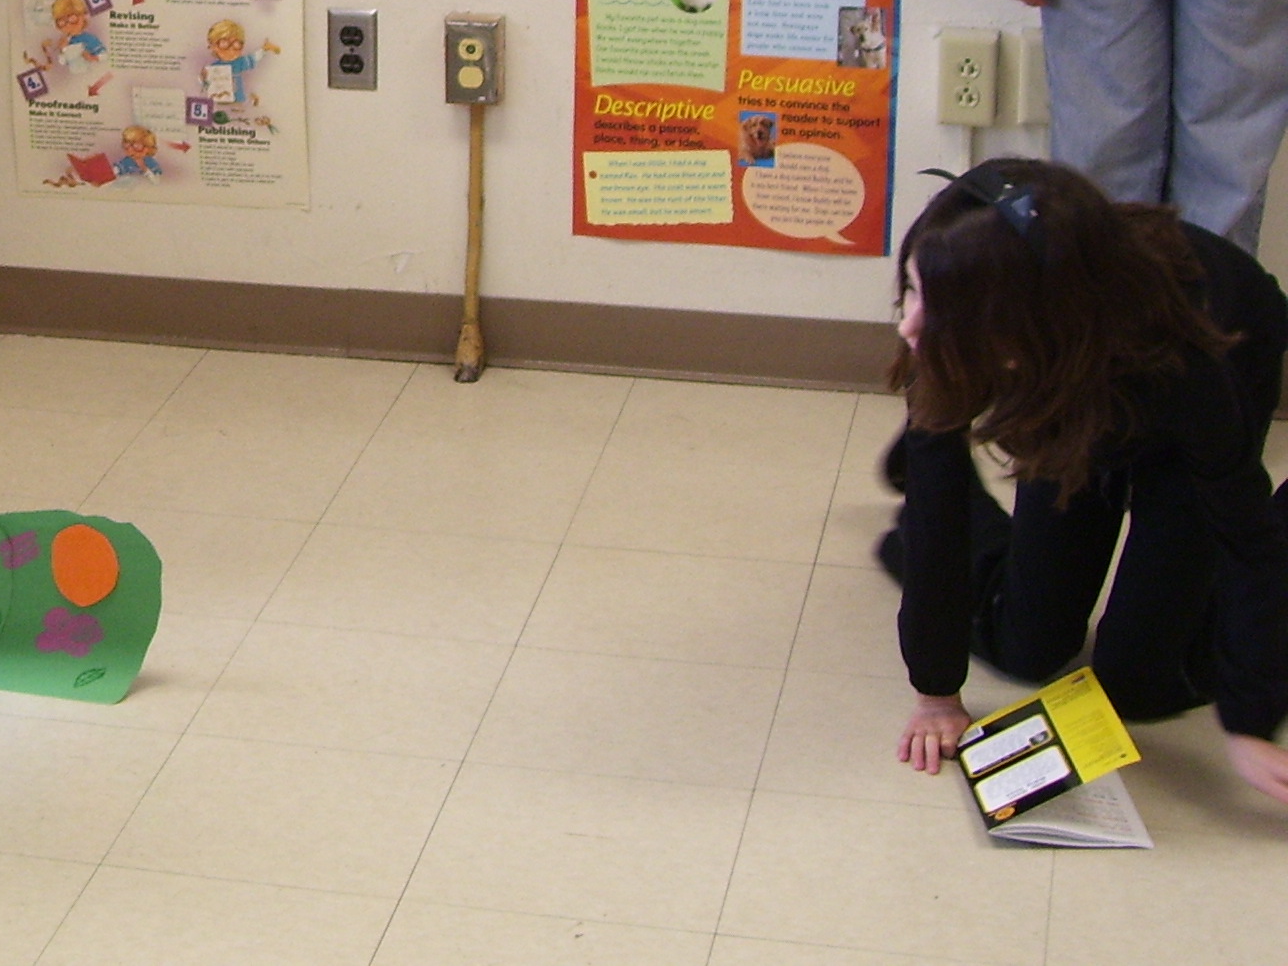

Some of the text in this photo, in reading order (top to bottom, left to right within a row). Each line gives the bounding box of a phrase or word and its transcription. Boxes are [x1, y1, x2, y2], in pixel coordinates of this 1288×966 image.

[109, 10, 155, 23] Revising
[737, 69, 856, 97] Persuasive
[28, 99, 99, 113] Proofreading
[593, 94, 716, 122] Descriptive
[765, 97, 777, 107] to
[198, 125, 256, 139] Publishing
[781, 127, 796, 136] an
